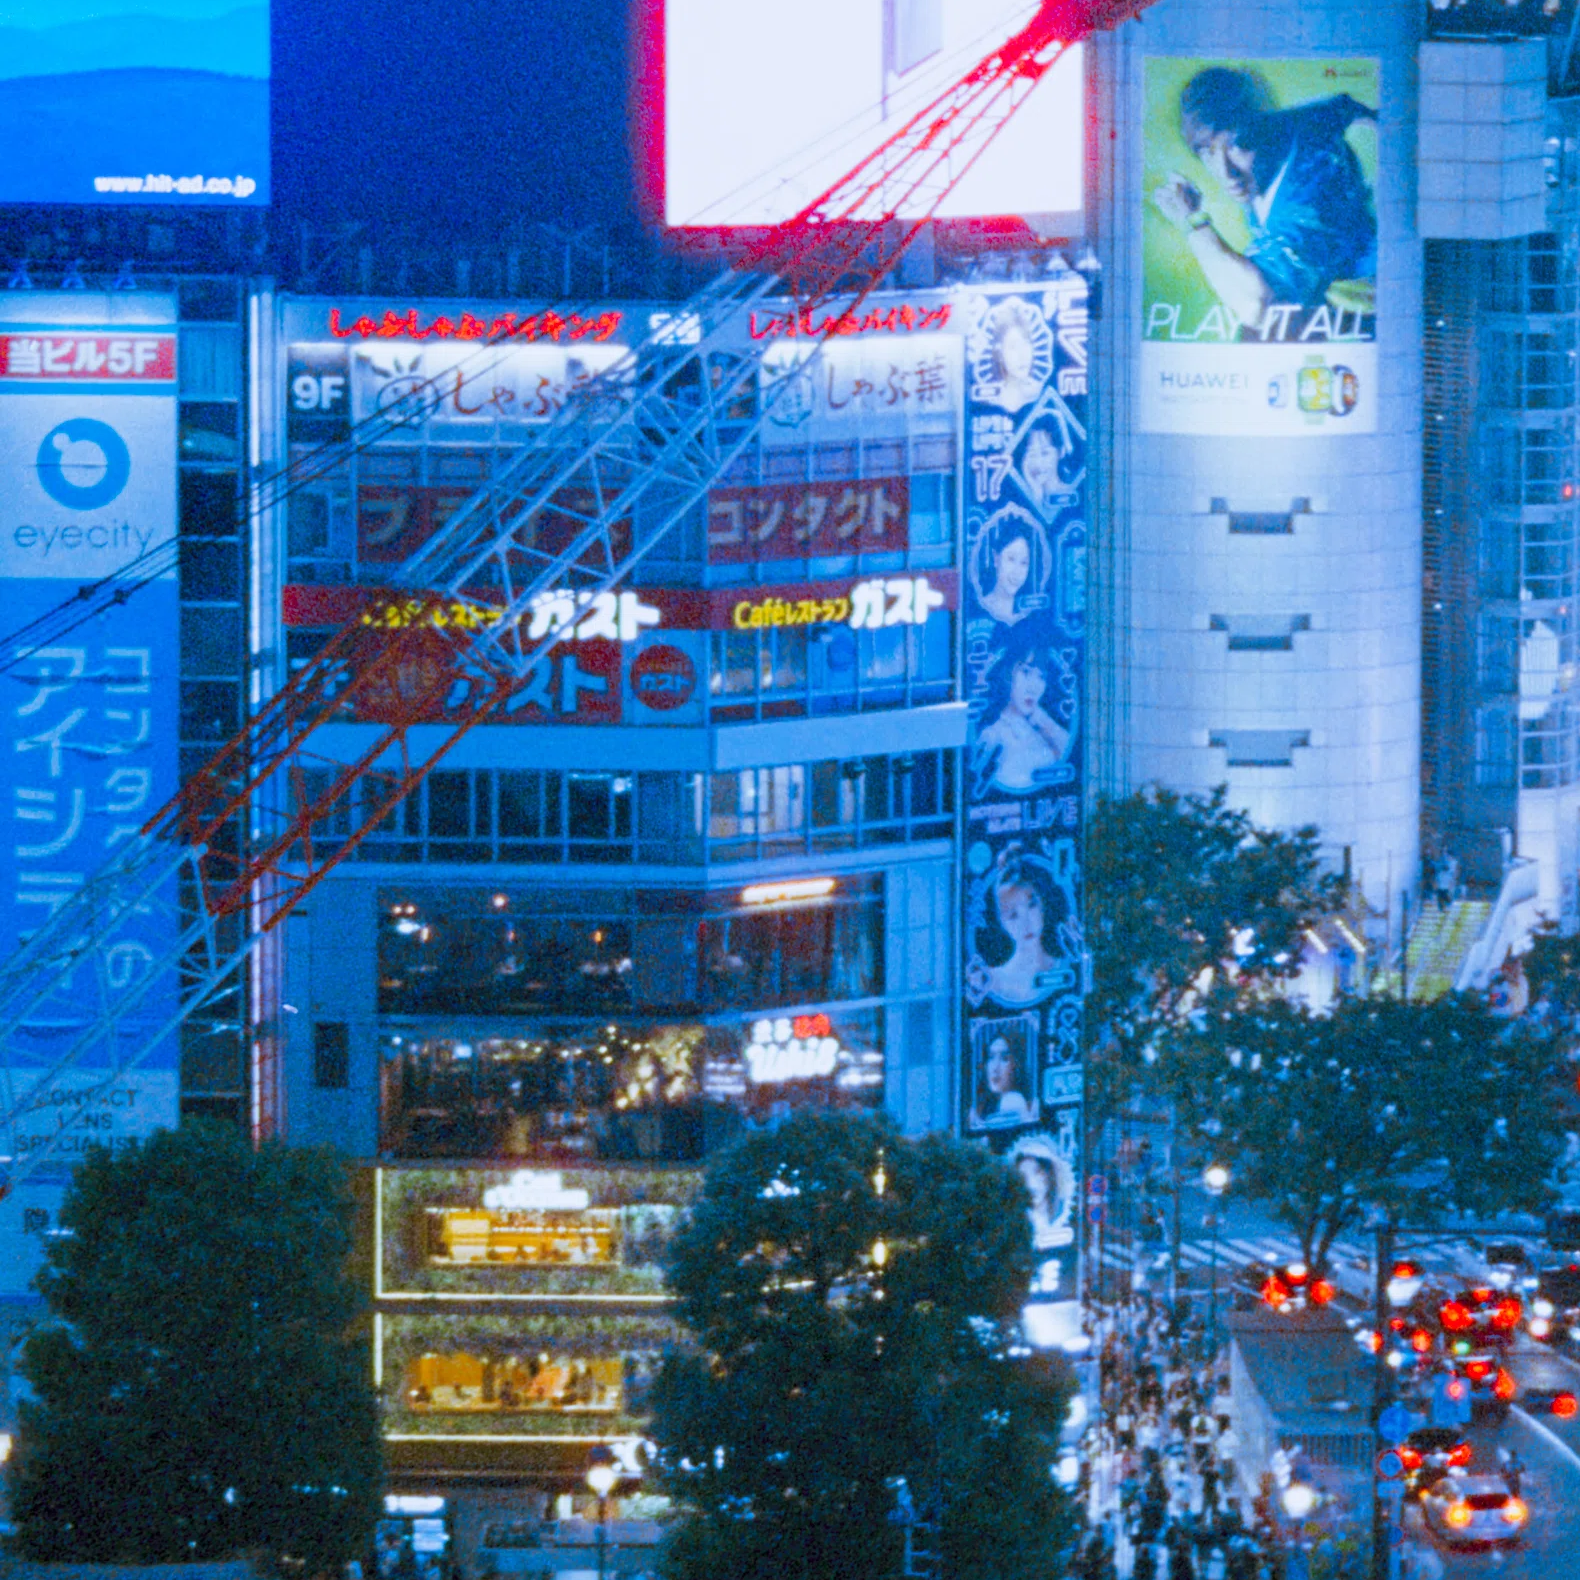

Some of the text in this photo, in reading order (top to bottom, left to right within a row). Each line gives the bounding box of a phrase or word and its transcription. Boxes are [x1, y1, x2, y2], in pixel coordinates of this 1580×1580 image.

[94, 174, 256, 198] www.hit-ad.co.jp
[1145, 303, 1373, 341] PLAY IT ALL
[8, 339, 159, 375] 当ビル5F
[292, 374, 346, 410] 9F
[826, 353, 949, 410] しゃぶ葉
[1159, 370, 1250, 391] HUAWEI
[707, 486, 902, 545] コンタクト
[13, 517, 154, 555] eyecity
[850, 577, 945, 630] ガスト
